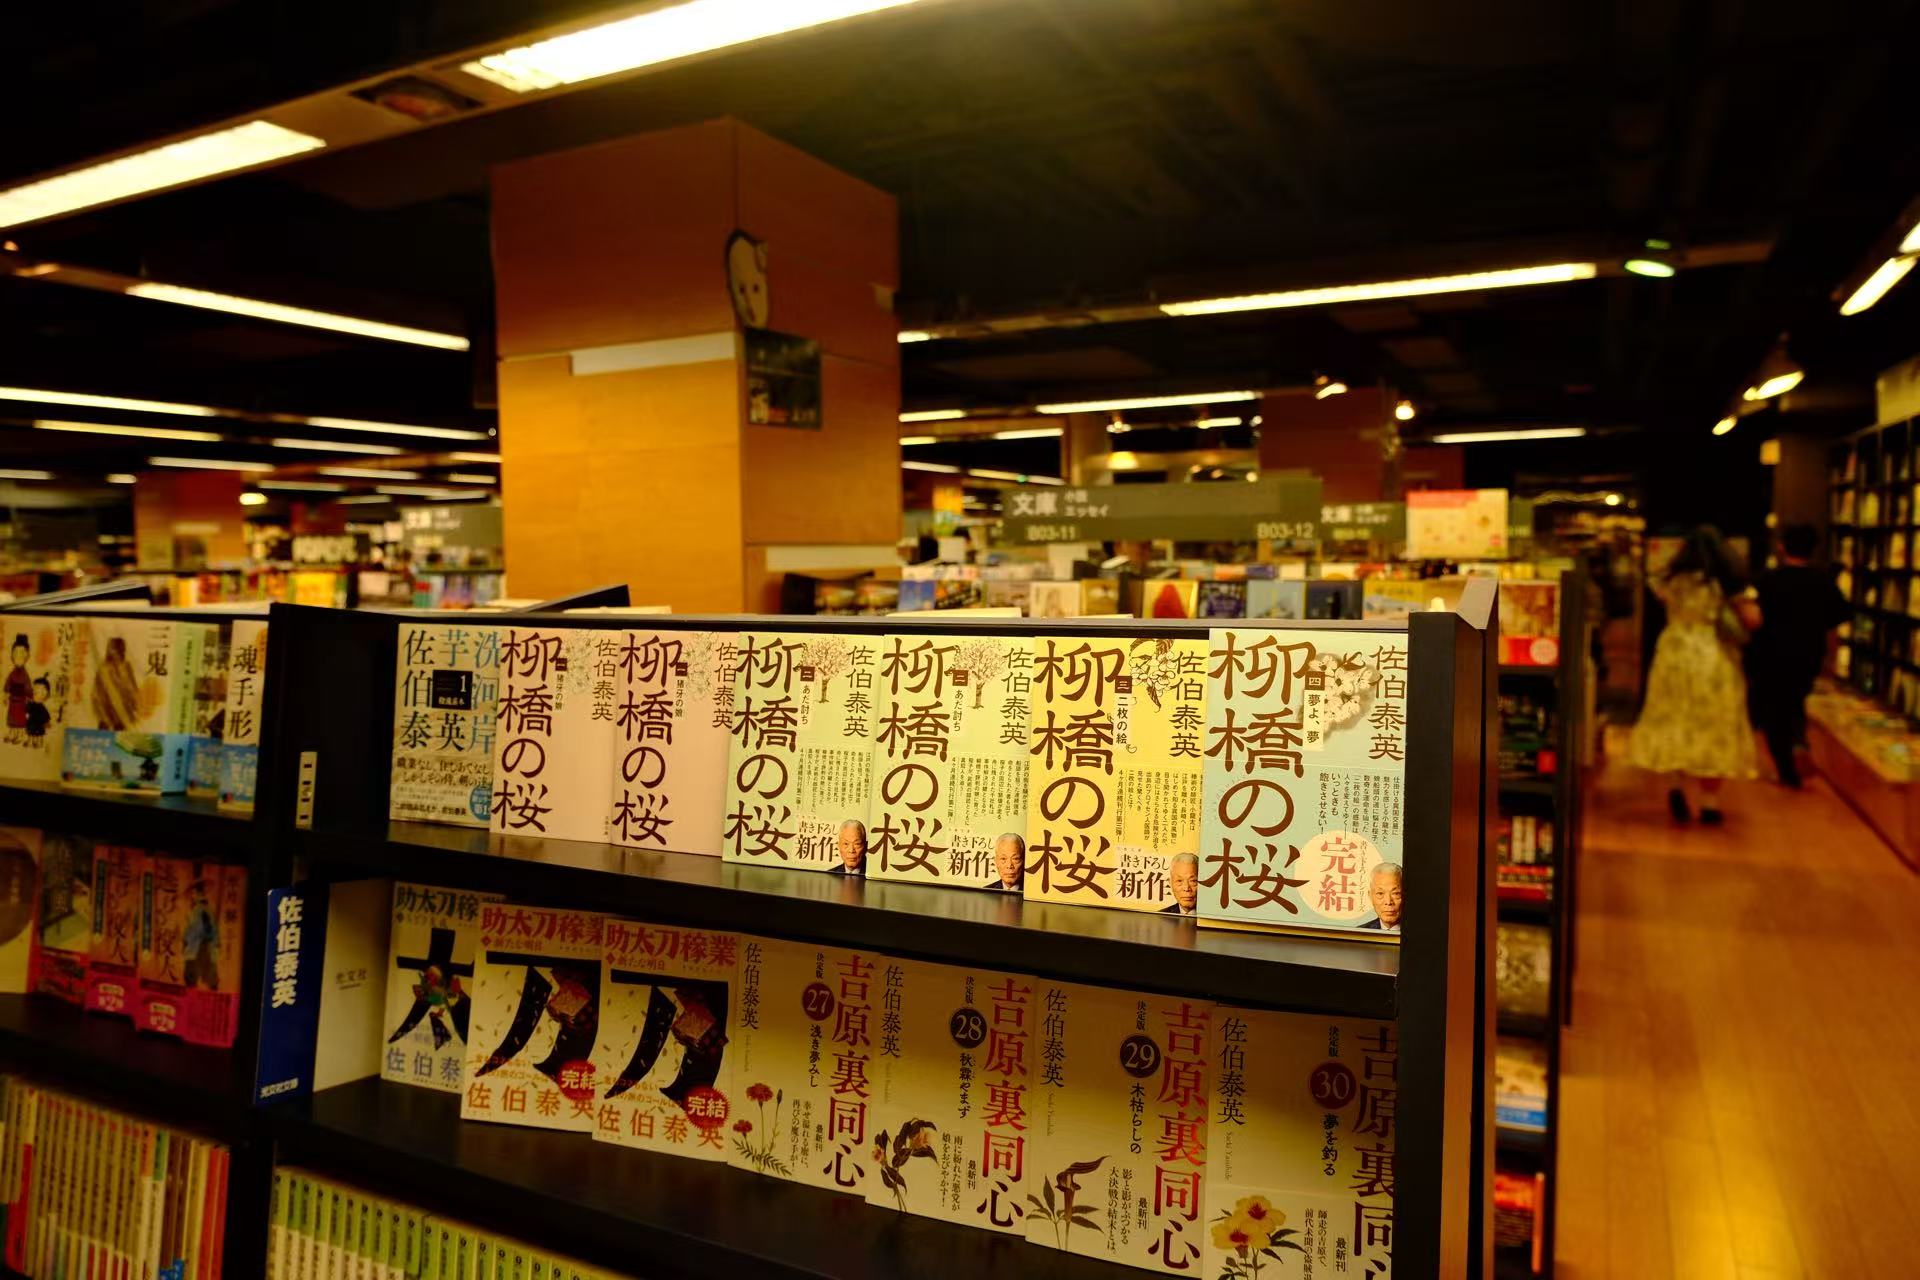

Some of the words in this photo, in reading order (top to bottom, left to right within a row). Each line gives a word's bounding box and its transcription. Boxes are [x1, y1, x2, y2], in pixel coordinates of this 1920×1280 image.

[230, 645, 258, 738] 魂手形
[592, 639, 619, 720] 佐伯泰英
[712, 642, 739, 729] 佐伯泰英
[801, 685, 812, 725] あだ討ち
[842, 645, 876, 738] 佐伯泰英
[953, 689, 964, 732] あだ討ち
[1000, 647, 1034, 746] 佐伯泰英
[1168, 650, 1206, 759] 佐伯泰英
[1367, 645, 1409, 761] 佐伯泰英
[492, 630, 562, 832] 柳橋の桜
[613, 633, 684, 845] 柳橋の桜
[724, 635, 803, 860] 柳橋の桜
[1116, 696, 1130, 745] 二枚の絵
[1306, 693, 1322, 745] 夢よ、夢
[868, 638, 959, 877] 柳橋の桜
[1024, 640, 1126, 899] 柳橋の桜
[1197, 631, 1316, 915] 柳橋の桜
[1331, 773, 1341, 817] いっときも
[795, 834, 840, 863] 新作
[947, 848, 998, 879] 新作
[951, 835, 996, 850] 書き下ろし
[1120, 853, 1171, 871] 書き下ろし
[1318, 837, 1359, 912] 完結
[396, 886, 506, 921] 助太刀稼
[1116, 869, 1172, 902] 新作
[272, 895, 305, 1010] 佐伯泰英
[482, 907, 605, 943] 助太刀稼業
[606, 923, 738, 968] 助太刀稼業
[742, 943, 762, 1030] 佐伯泰英
[807, 988, 829, 1011] 27
[880, 965, 904, 1059] 佐伯泰英
[810, 1024, 822, 1088] 浅き夢みし
[955, 1013, 983, 1042] 28
[1041, 988, 1068, 1089] 佐伯泰英
[1124, 1042, 1155, 1071] 29
[467, 1082, 595, 1121] 佐伯泰英
[687, 1094, 727, 1118] 完結
[823, 954, 876, 1188] 吉原裏同心
[976, 977, 1032, 1228] 吉原裏同心
[1218, 1016, 1248, 1126] 佐伯泰英
[1315, 1071, 1351, 1100] 30
[597, 1103, 725, 1150] 佐伯泰英
[1129, 1083, 1145, 1154] 木枯らしの
[1147, 1002, 1210, 1270] 吉原裏同心
[1321, 1113, 1339, 1177] 夢を釣る
